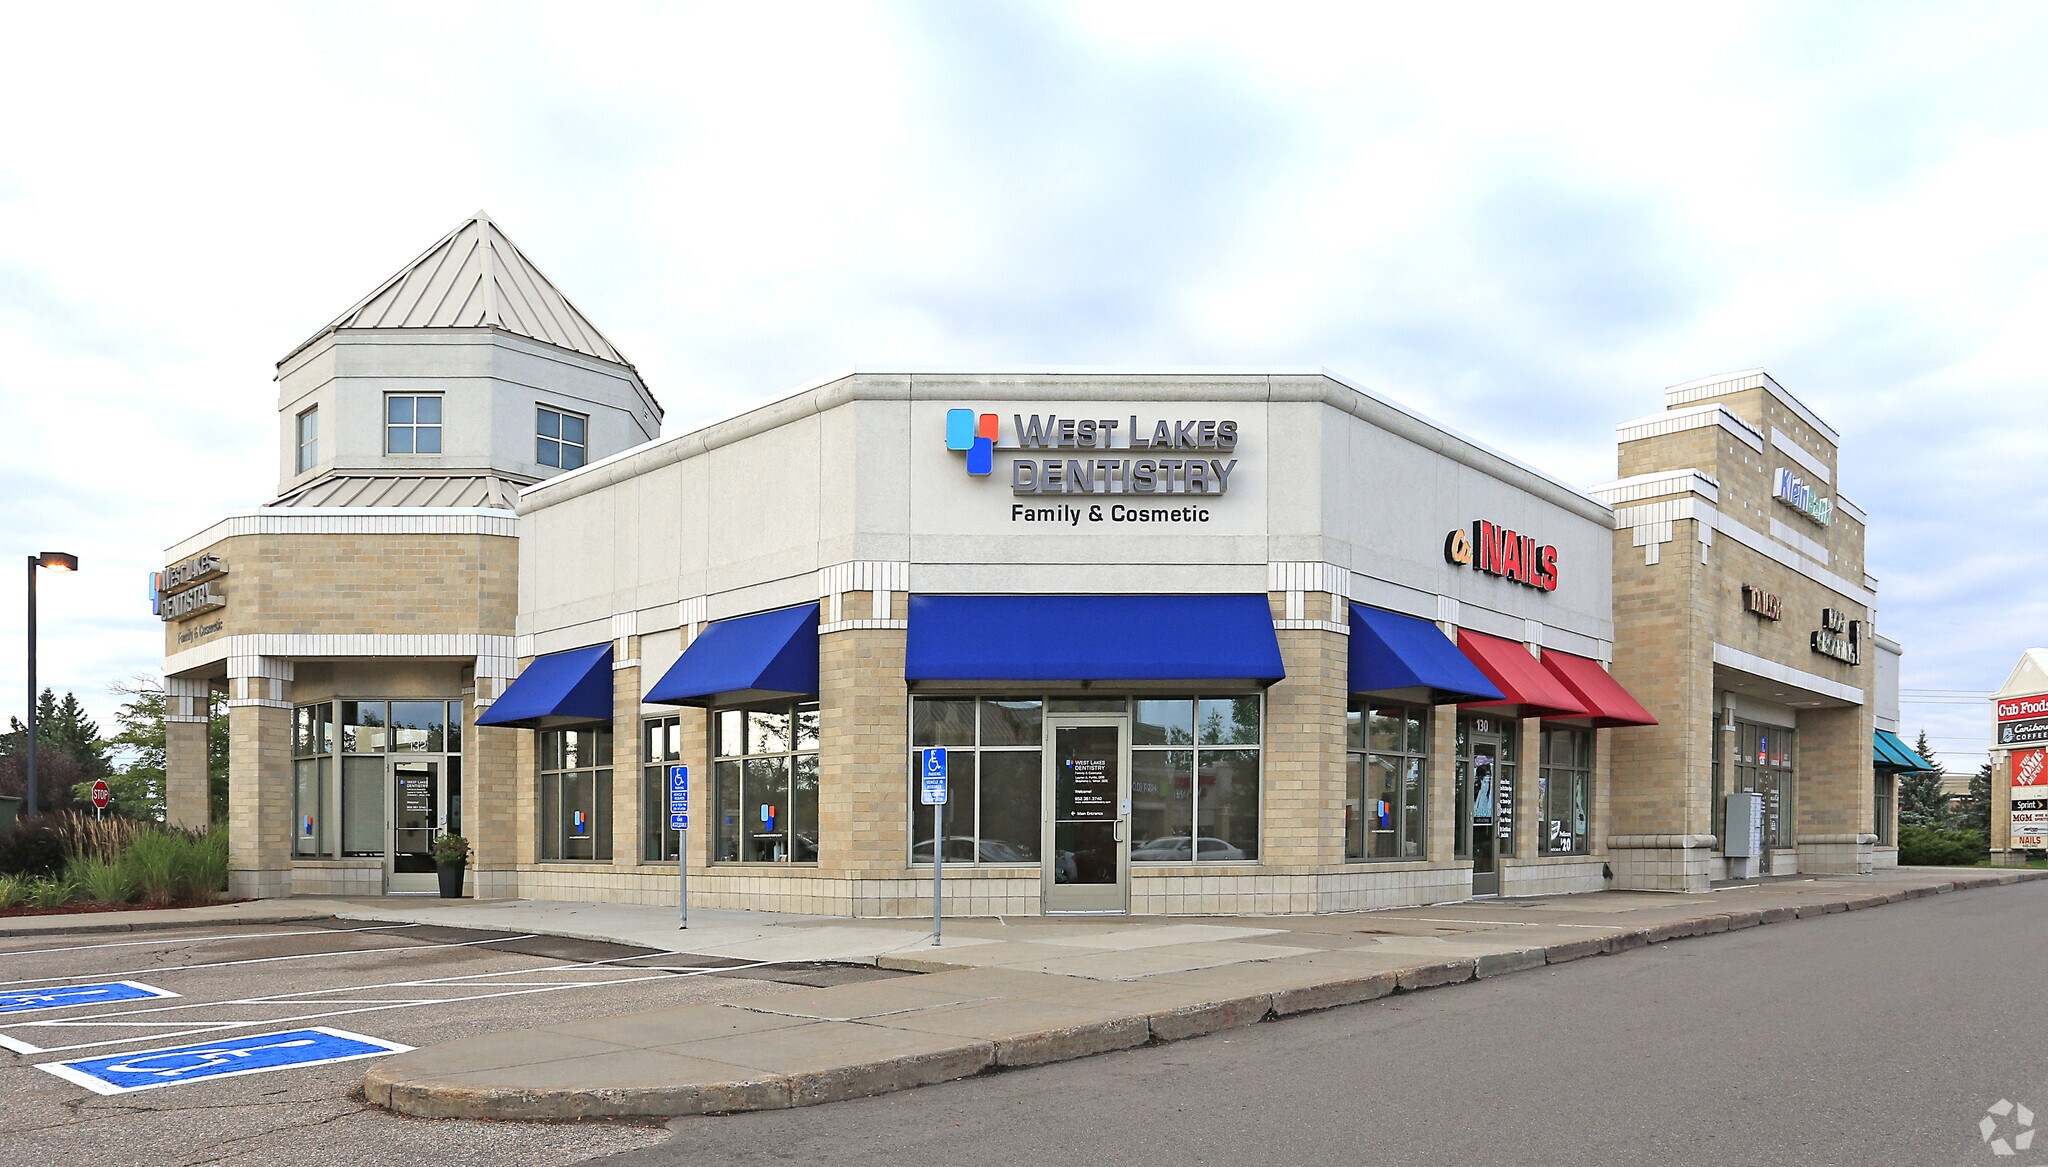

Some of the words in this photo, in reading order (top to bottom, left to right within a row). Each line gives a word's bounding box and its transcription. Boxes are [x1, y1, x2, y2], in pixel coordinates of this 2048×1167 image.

[1014, 414, 1118, 449] WEST
[1129, 415, 1238, 449] LAKES
[1013, 460, 1238, 493] DENTISTRY
[1012, 504, 1080, 526] Family
[1088, 504, 1104, 522] &
[1111, 504, 1210, 522] Cosmetic
[1474, 519, 1558, 592] NAILS
[161, 581, 221, 621] DENTISTRY
[178, 628, 194, 644] Family
[200, 617, 223, 637] Cosmetic
[1999, 704, 2018, 716] Cub
[1476, 719, 1489, 733] 130
[2016, 732, 2048, 740] COFFEE
[410, 740, 427, 752] 132
[2017, 749, 2044, 785] HOME
[2020, 754, 2031, 768] THE
[2027, 762, 2044, 785] DEPOT
[93, 789, 108, 800] STOP
[2017, 801, 2036, 810] Sprint
[2013, 814, 2033, 822] MGM
[2020, 836, 2042, 844] NAILS
